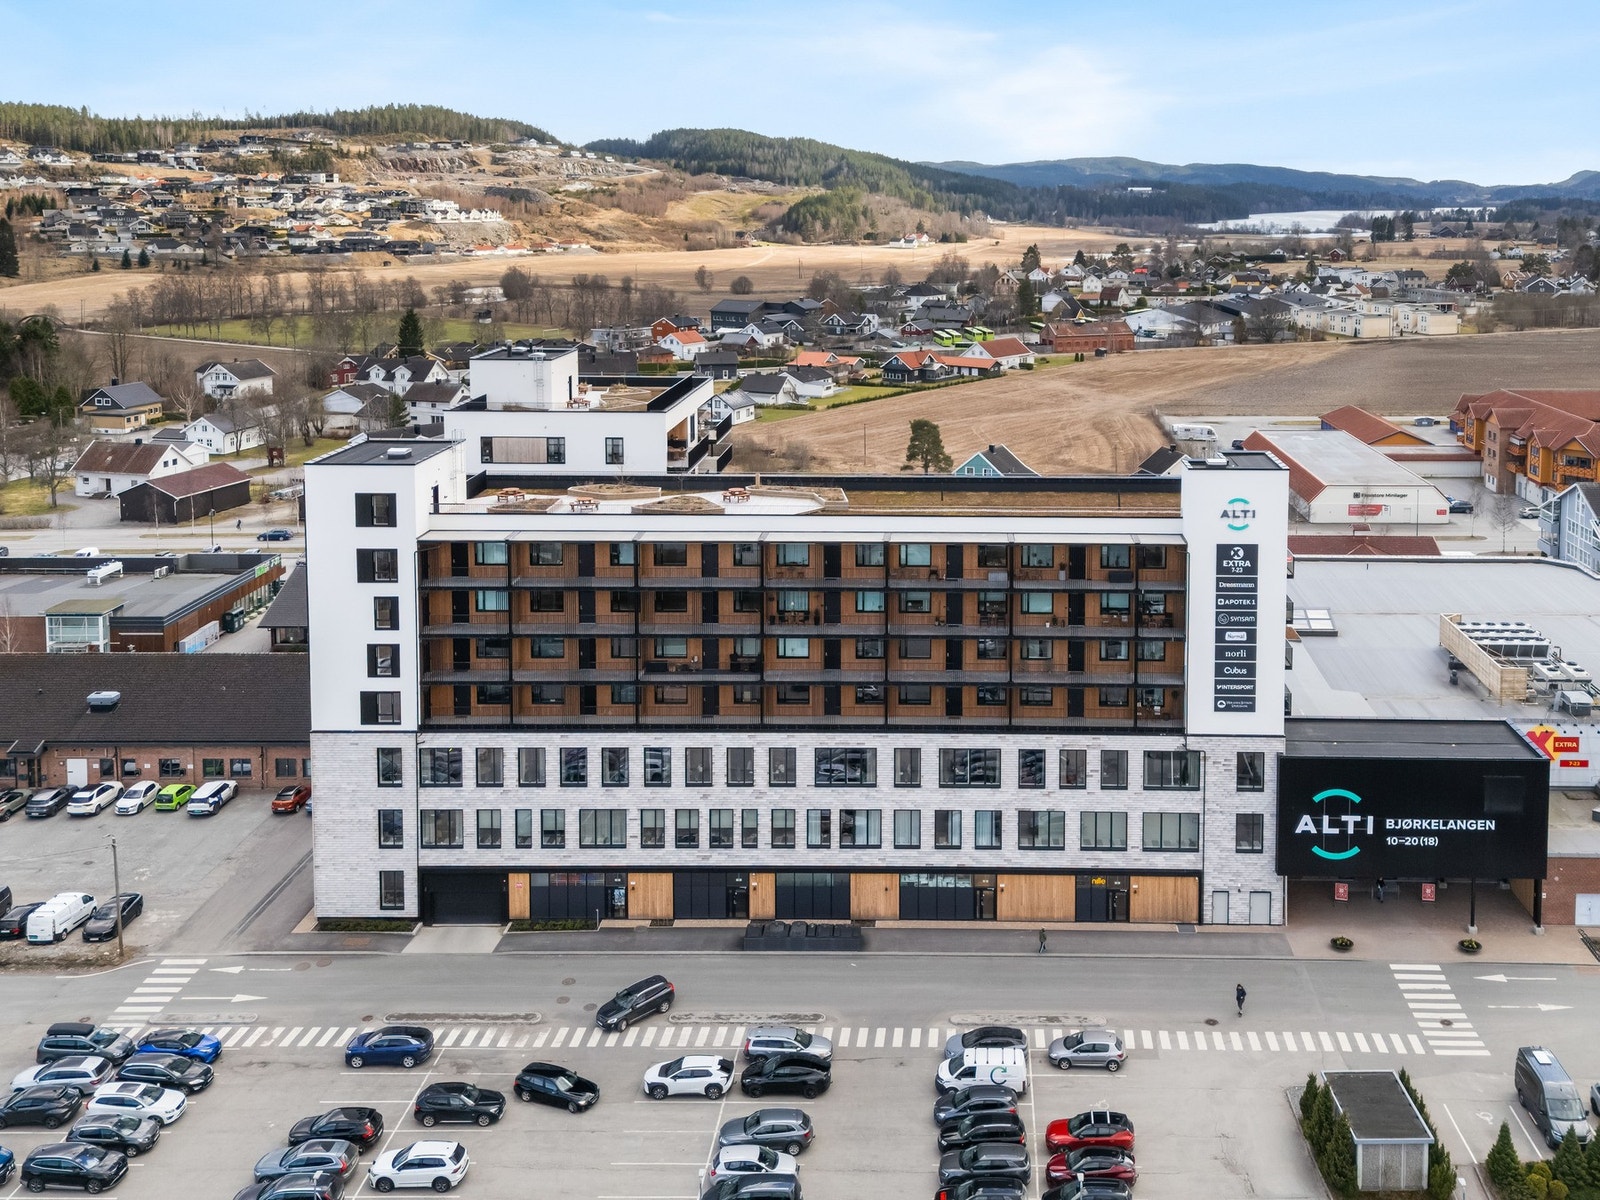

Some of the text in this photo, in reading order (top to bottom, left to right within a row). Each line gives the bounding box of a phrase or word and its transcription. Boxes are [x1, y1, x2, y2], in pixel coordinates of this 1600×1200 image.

[1220, 509, 1256, 519] ALTI
[1225, 649, 1247, 657] norli
[1224, 666, 1247, 675] Cubus
[1295, 814, 1496, 835] ALTI BJØRKELANGEN
